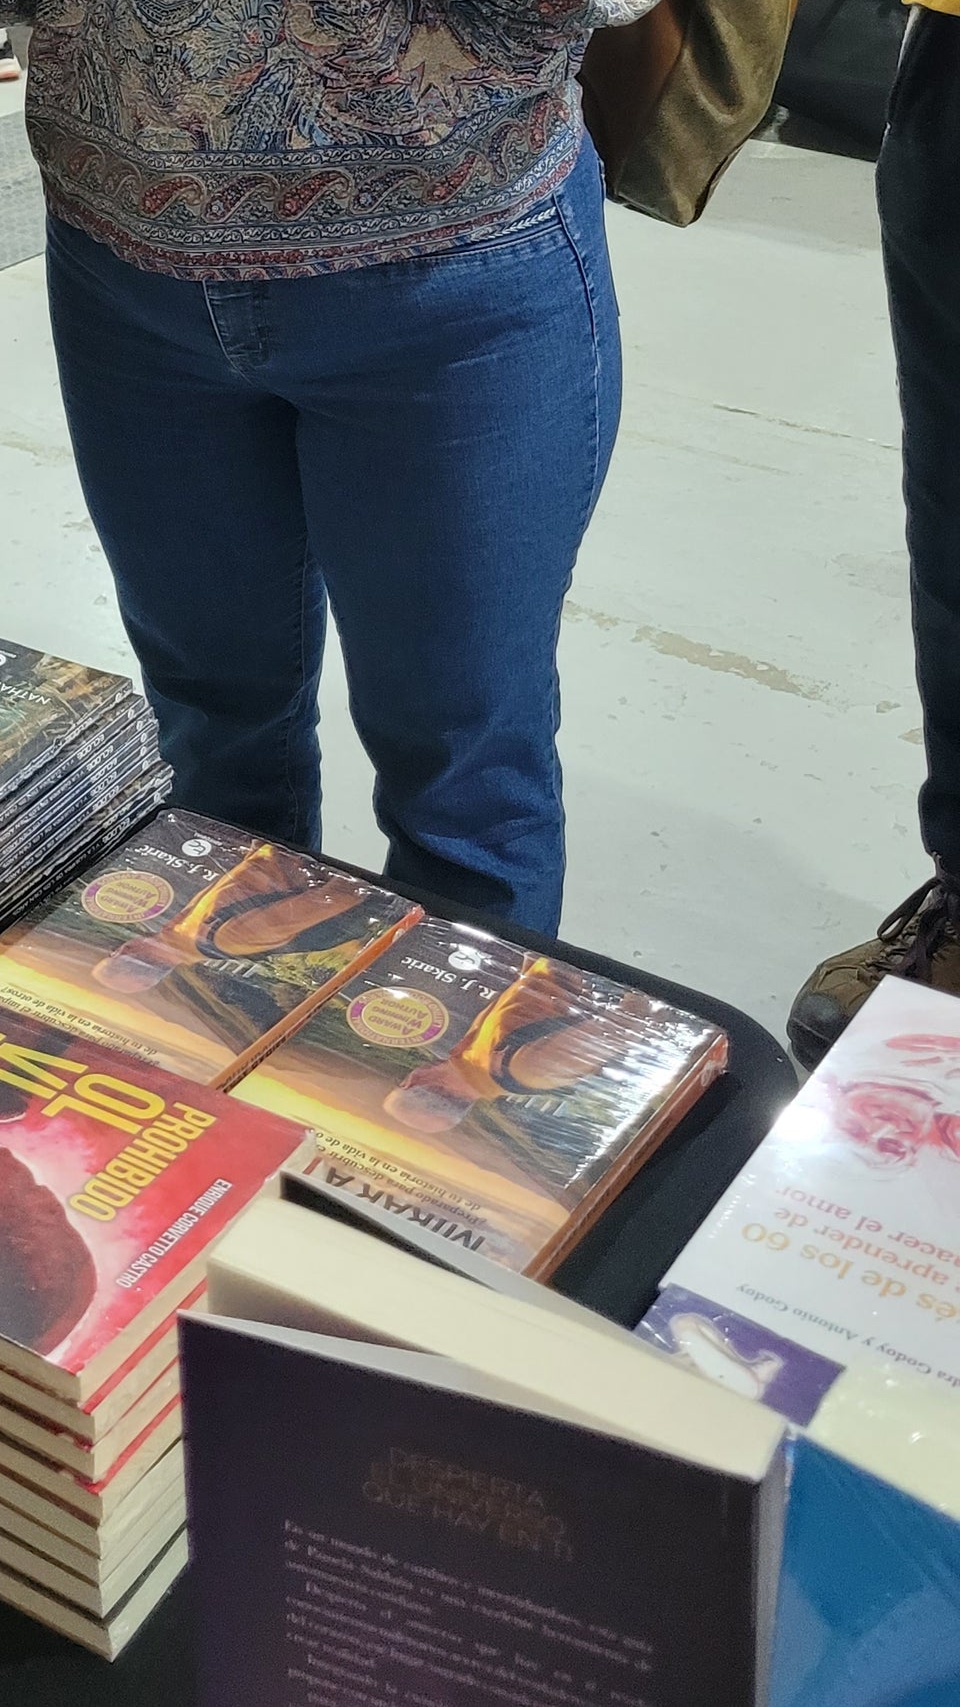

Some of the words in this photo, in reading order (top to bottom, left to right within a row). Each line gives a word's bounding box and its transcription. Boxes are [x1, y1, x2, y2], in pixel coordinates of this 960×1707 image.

[460, 977, 477, 992] J.
[478, 984, 498, 1001] R.
[67, 1101, 217, 1222] PROHIBIDO
[188, 1178, 233, 1218] ENRIQUE
[775, 1186, 852, 1221] amor
[774, 1207, 809, 1228] de
[854, 1216, 883, 1234] el
[148, 1212, 199, 1257] CORVETTO
[742, 1223, 790, 1251] 60
[115, 1252, 158, 1289] CASTRO
[800, 1244, 854, 1280] los
[813, 1223, 950, 1287] aprender
[736, 1283, 789, 1313] Godoy
[860, 1270, 908, 1299] de
[792, 1307, 859, 1341] Antonio
[861, 1336, 875, 1347] y
[876, 1342, 932, 1375] Godoy
